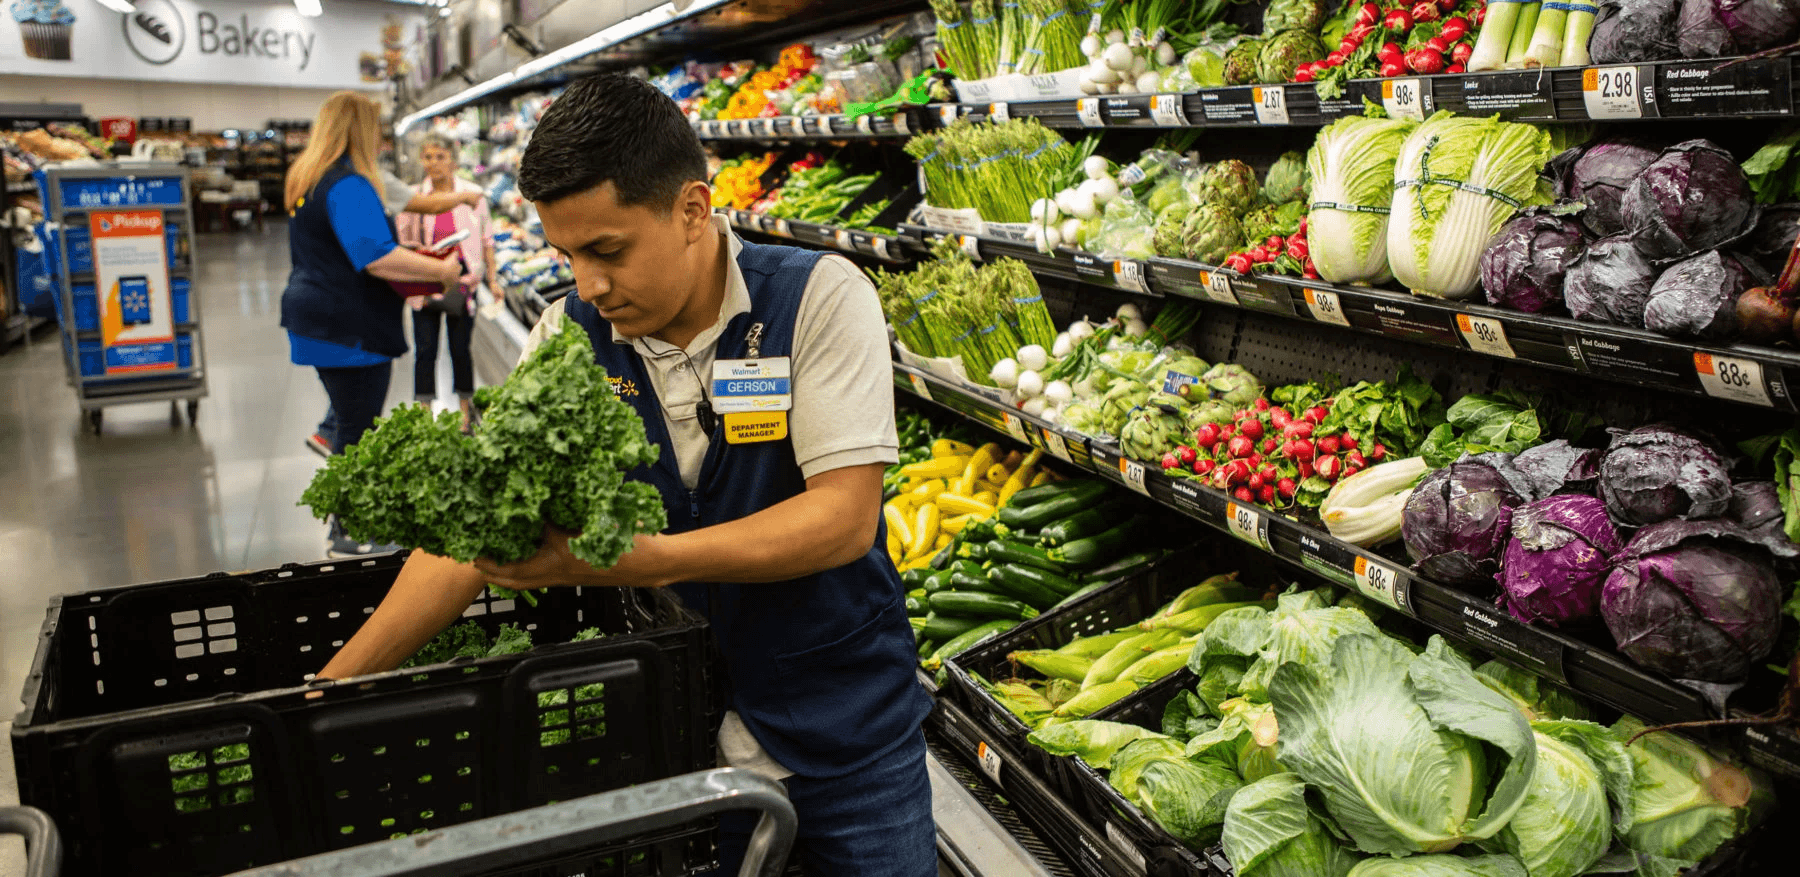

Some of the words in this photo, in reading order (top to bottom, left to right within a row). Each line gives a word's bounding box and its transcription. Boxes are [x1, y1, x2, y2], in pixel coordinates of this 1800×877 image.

[198, 11, 315, 71] Bakery
[1666, 70, 1679, 78] Red
[1680, 69, 1709, 79] Cabbage
[1264, 91, 1280, 108] 2.87
[1396, 84, 1413, 105] 98¢
[1643, 86, 1653, 104] USA
[113, 214, 161, 230] Pickup
[1317, 293, 1334, 312] 98¢
[1473, 321, 1498, 342] 98¢
[1581, 337, 1593, 347] Red
[1593, 340, 1620, 352] Cabbage
[731, 367, 761, 375] Walmart
[1718, 361, 1751, 388] 88¢
[727, 381, 776, 393] GERSON
[731, 421, 780, 433] DEPARTMENT
[738, 429, 775, 439] MANAGER
[1238, 510, 1252, 531] 98¢
[1368, 566, 1387, 591] 98¢
[1463, 606, 1475, 617] Red
[1474, 611, 1499, 628] Cabbage
